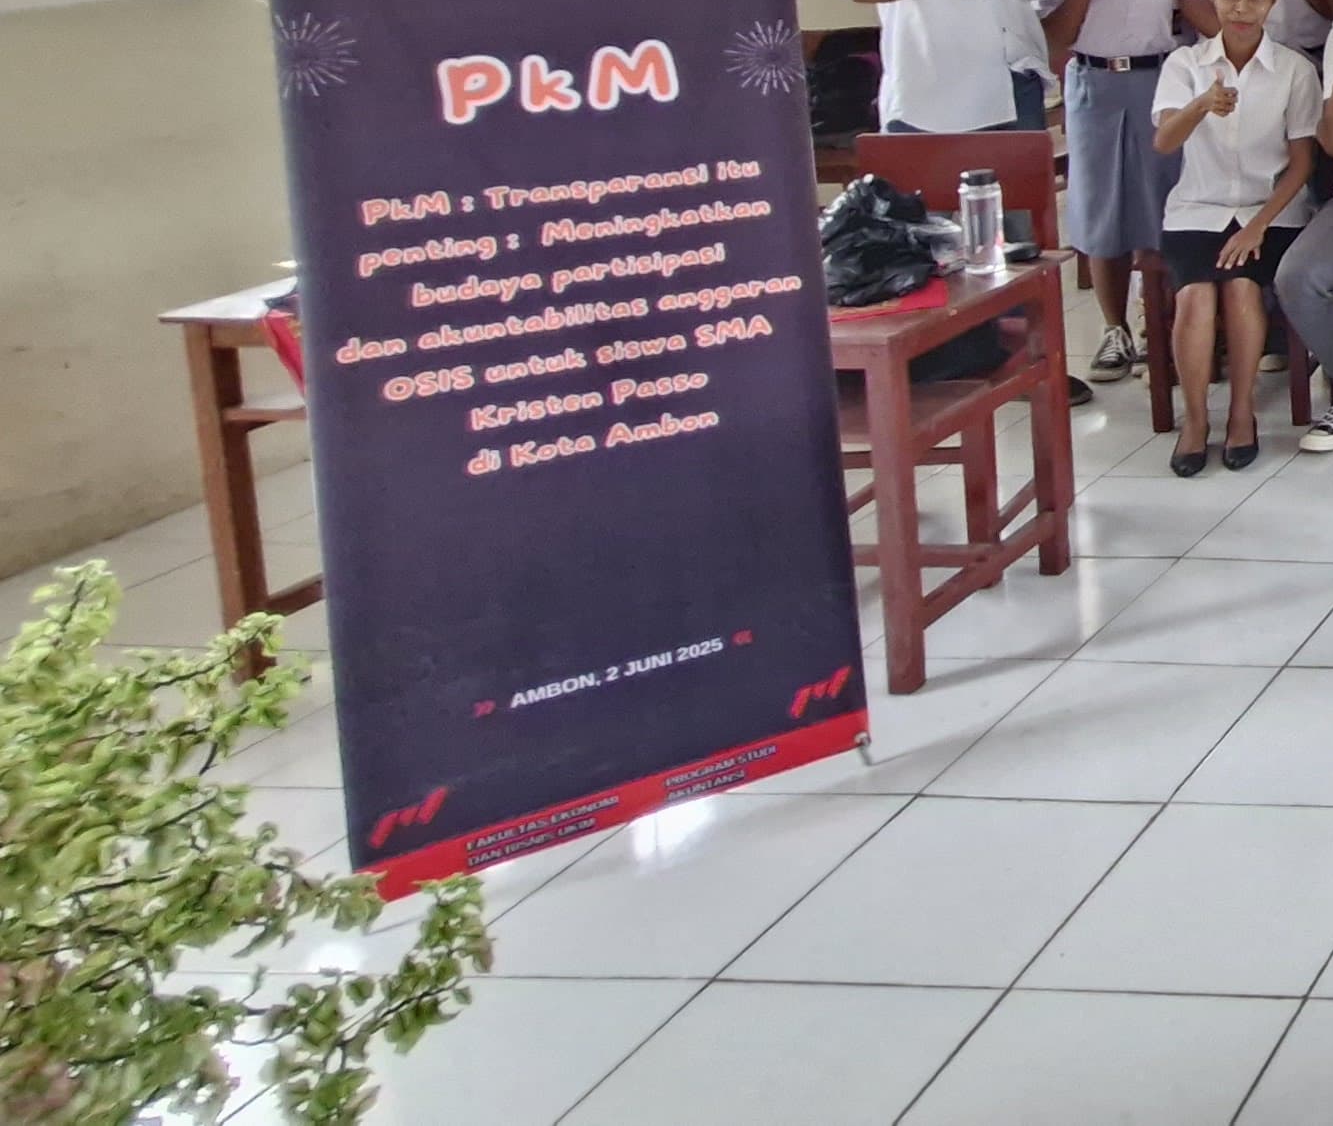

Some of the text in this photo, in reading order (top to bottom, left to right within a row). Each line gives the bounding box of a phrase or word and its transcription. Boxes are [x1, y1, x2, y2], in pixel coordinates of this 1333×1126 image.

[436, 38, 680, 125] PkM
[361, 190, 452, 227] PkM
[485, 163, 709, 211] Transparansi
[716, 159, 760, 182] itu
[358, 235, 498, 279] penting
[541, 198, 772, 247] Meningkatkan
[410, 242, 726, 309] budaya partisipasi
[335, 273, 803, 365] dan akuntabilitas anggaran
[382, 314, 774, 402] OSIS untuk siswa SMA
[470, 371, 710, 432] Kristen Passo
[466, 410, 719, 476] di Kota Ambon
[509, 637, 724, 709] AMBON, 2 JUNI 2025
